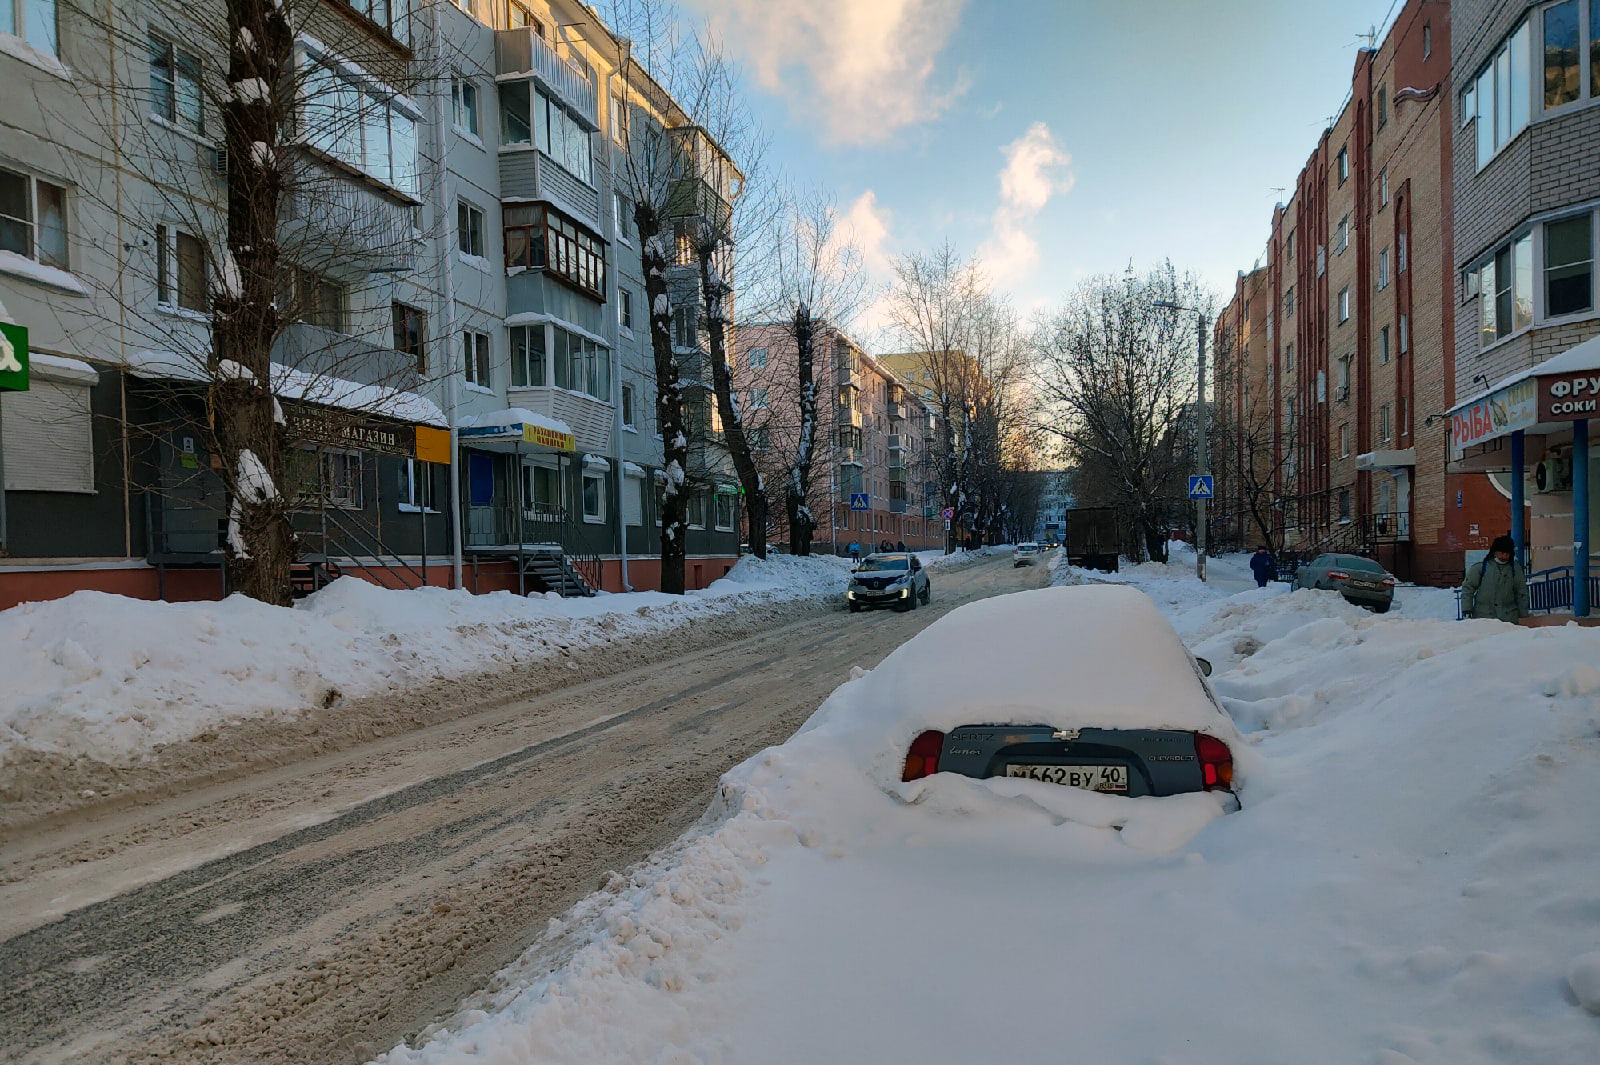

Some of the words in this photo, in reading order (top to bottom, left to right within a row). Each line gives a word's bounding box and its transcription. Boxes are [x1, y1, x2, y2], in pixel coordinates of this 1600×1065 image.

[1551, 400, 1597, 414] СОКИ
[1453, 402, 1492, 446] РЫБА
[341, 426, 395, 446] МАГАЗИН
[1101, 767, 1120, 782] 40
